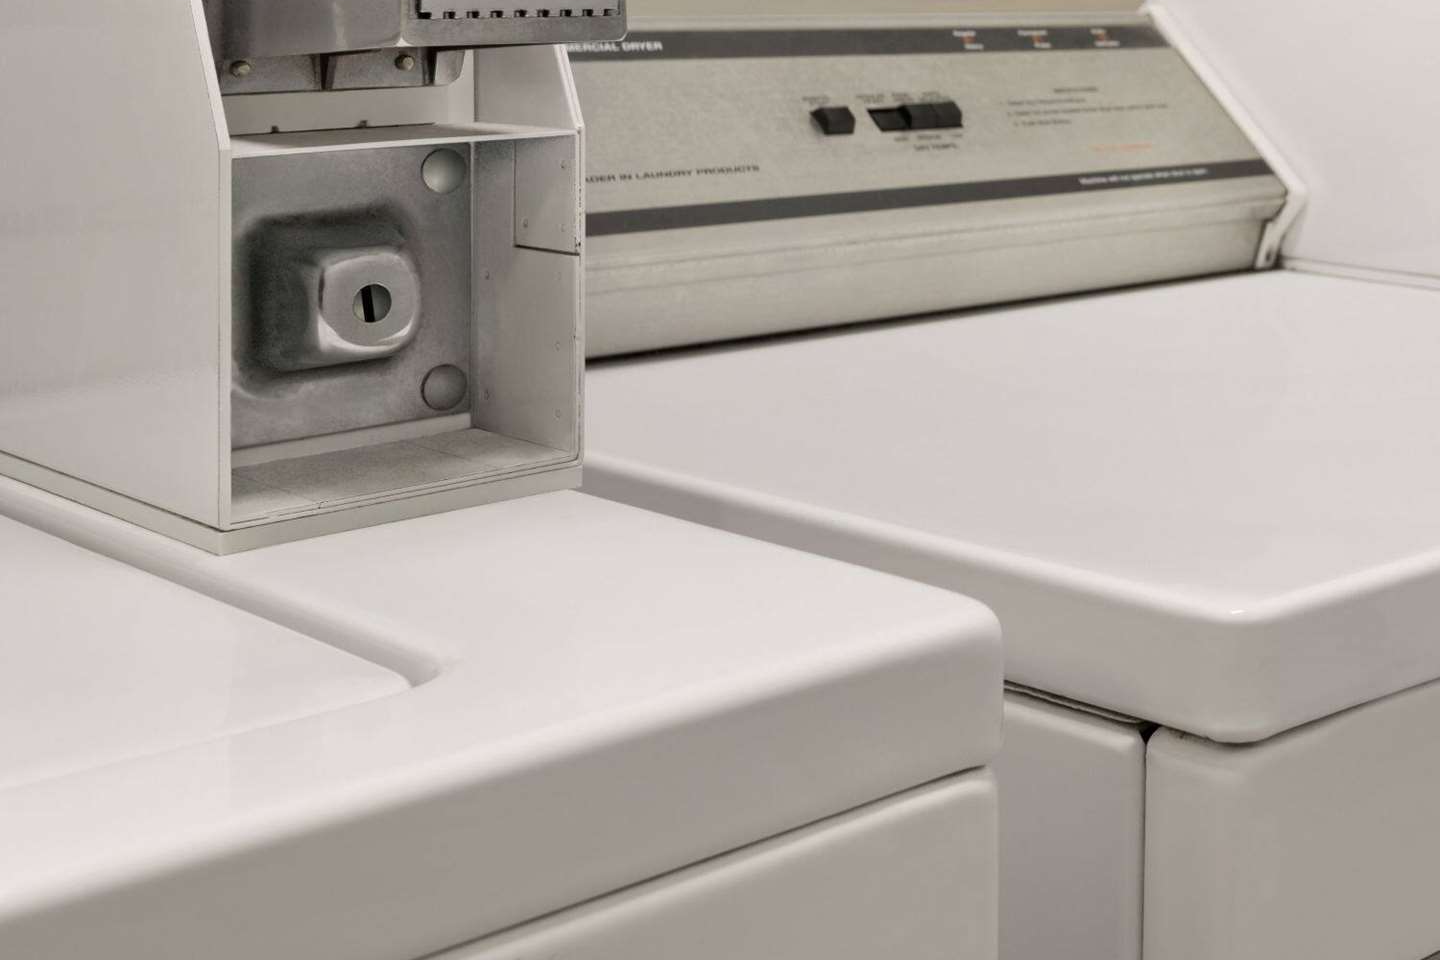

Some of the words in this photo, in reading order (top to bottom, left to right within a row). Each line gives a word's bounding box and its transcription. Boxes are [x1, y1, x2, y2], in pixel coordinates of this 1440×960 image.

[621, 40, 663, 52] DRYER
[619, 173, 633, 182] IN
[635, 169, 693, 181] LAUNDRY
[696, 164, 760, 176] PRODUCTS
